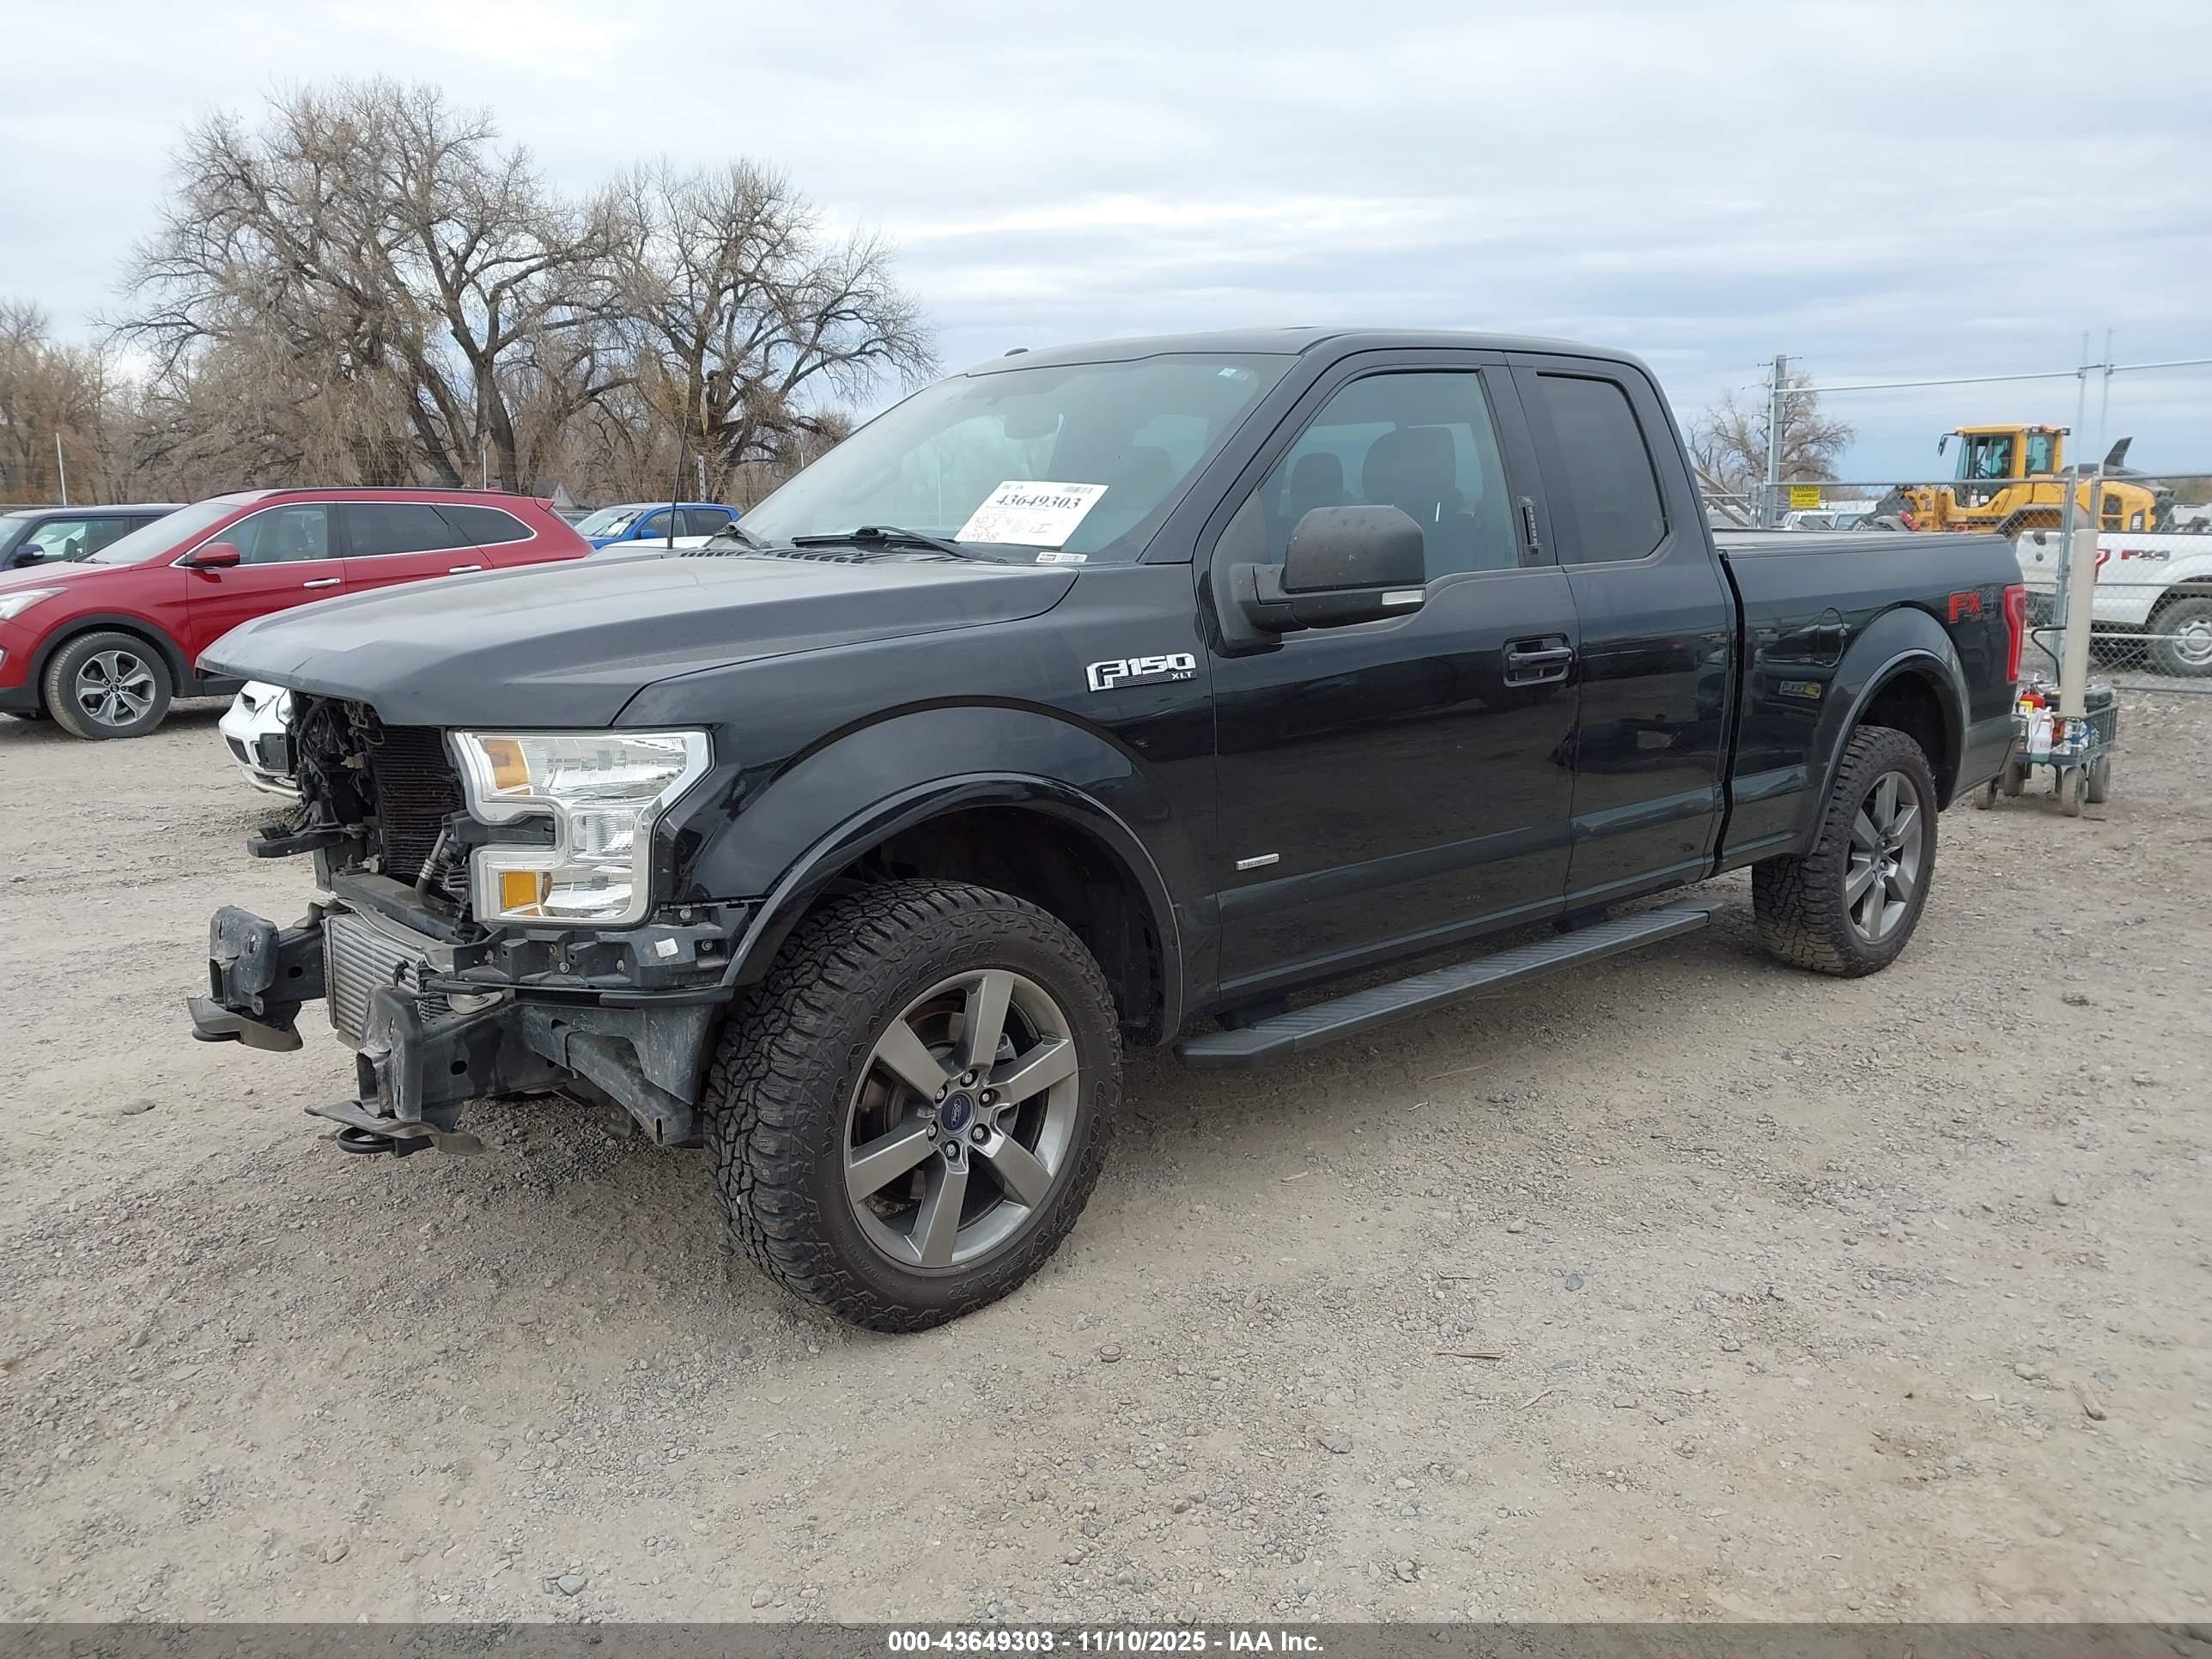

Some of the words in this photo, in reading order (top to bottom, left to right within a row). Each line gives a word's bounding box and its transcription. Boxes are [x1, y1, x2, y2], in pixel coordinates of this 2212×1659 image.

[996, 494, 1082, 509] 43649303
[1949, 586, 1999, 623] FX4
[1171, 671, 1193, 679] XLT
[948, 1079, 1106, 1302] GOODYEAR
